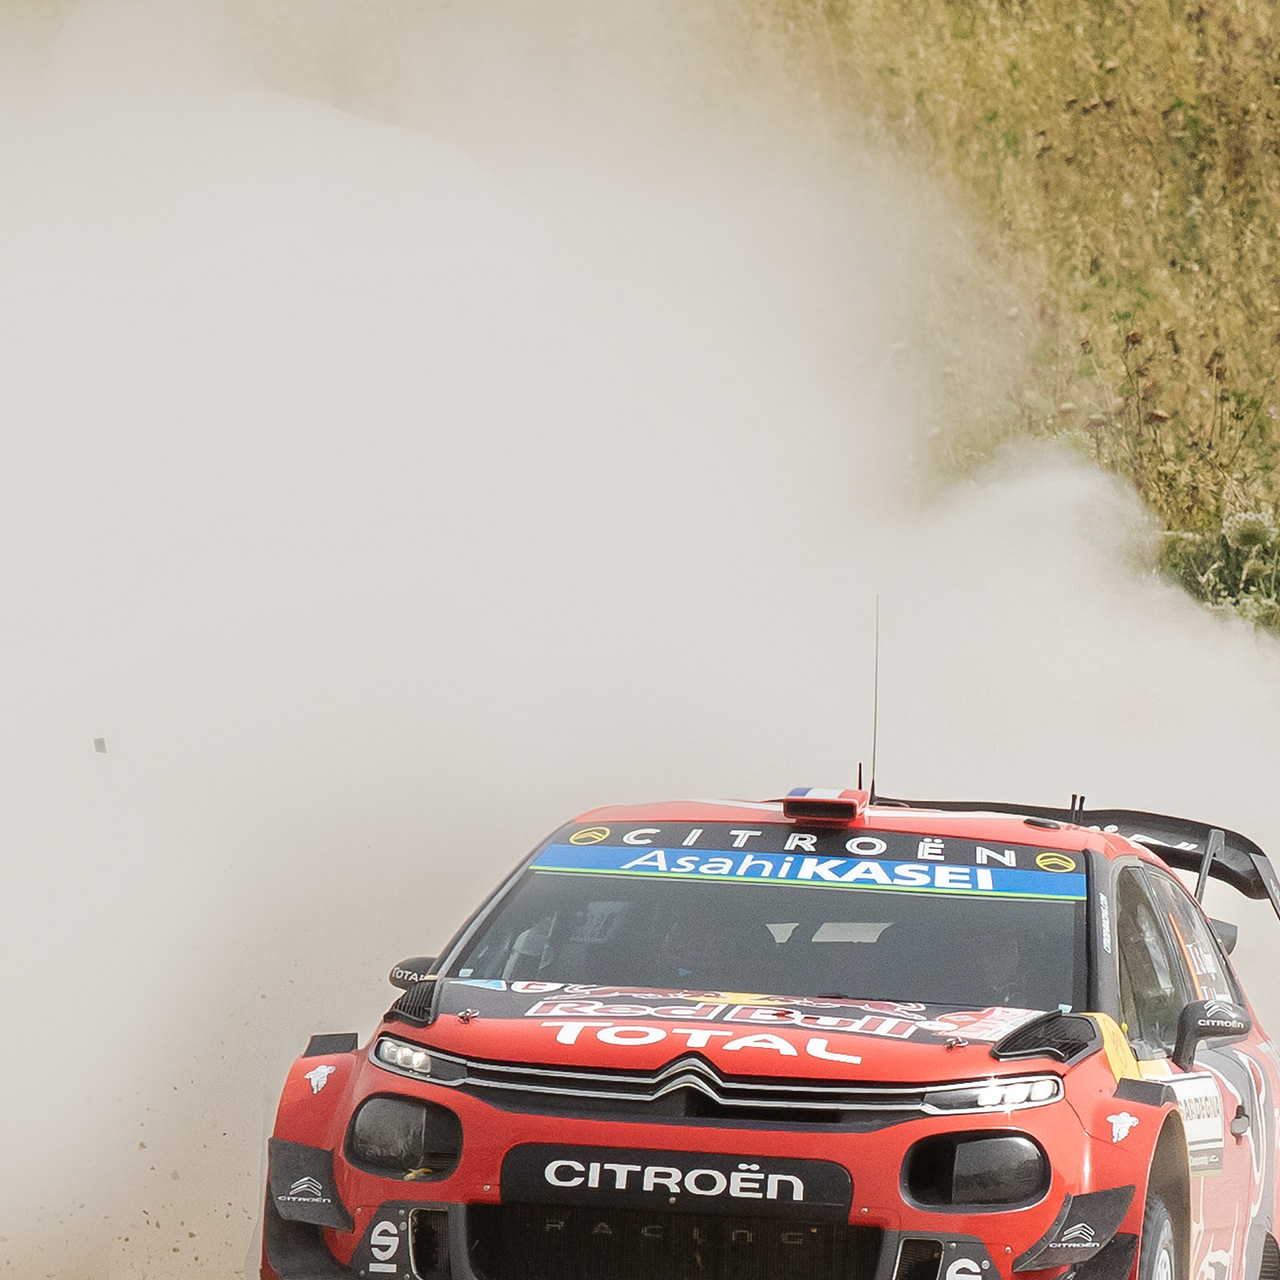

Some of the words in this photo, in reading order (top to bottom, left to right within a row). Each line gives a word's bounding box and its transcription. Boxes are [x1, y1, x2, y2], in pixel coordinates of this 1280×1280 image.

[622, 828, 1018, 868] CITROËN
[524, 1000, 720, 1021] Red
[723, 1003, 918, 1039] Bull
[541, 1021, 862, 1065] TOTAL
[544, 1159, 805, 1201] CITROËN
